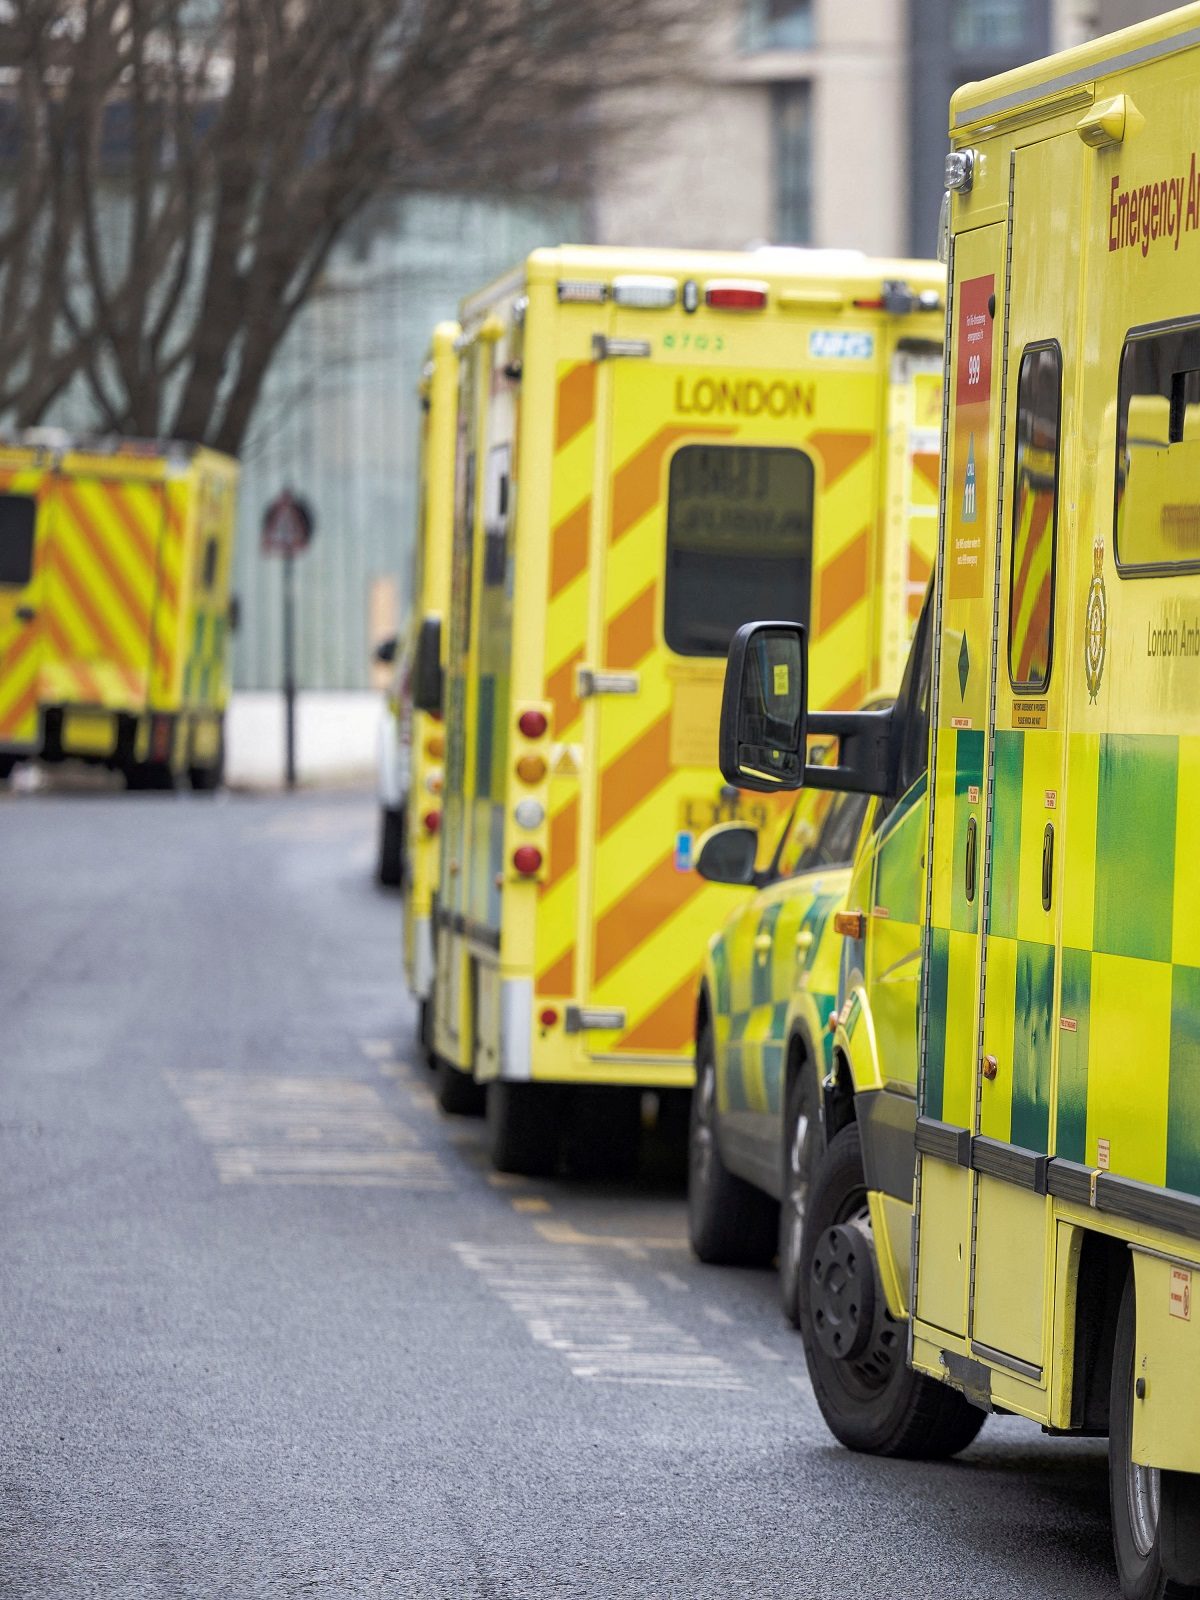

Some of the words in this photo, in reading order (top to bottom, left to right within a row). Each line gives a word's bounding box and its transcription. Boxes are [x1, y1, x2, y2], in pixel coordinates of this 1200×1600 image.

[1109, 175, 1185, 258] Emergency
[969, 354, 980, 385] 999
[674, 375, 816, 419] LONDON
[1147, 618, 1178, 657] London
